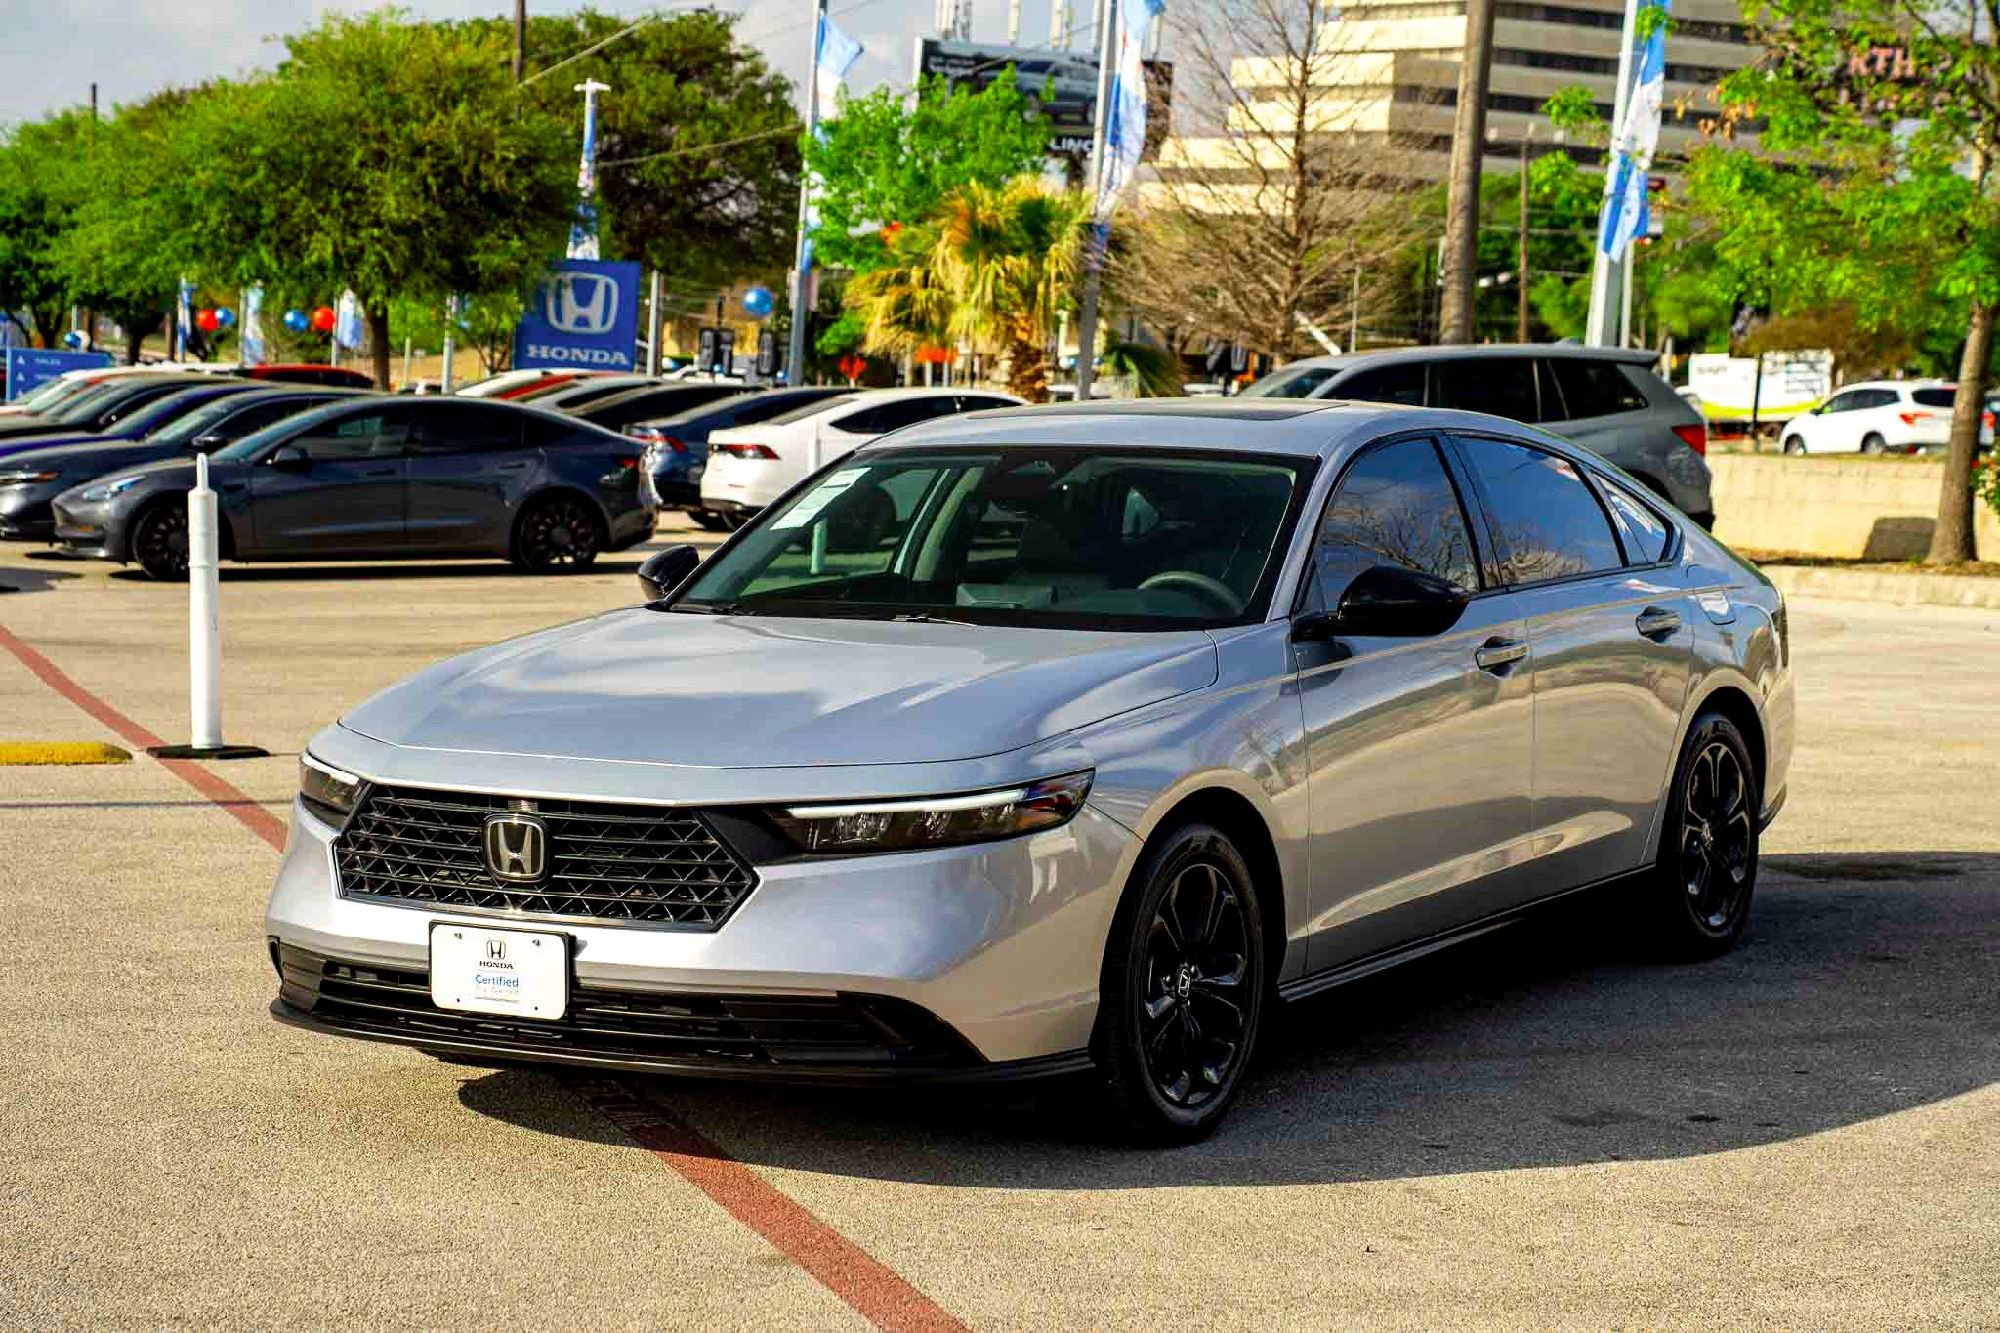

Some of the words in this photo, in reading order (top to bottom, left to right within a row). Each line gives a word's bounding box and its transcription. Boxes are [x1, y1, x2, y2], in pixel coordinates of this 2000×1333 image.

[527, 344, 631, 365] HONDA
[479, 960, 514, 970] HONDA
[475, 974, 519, 988] Certified
